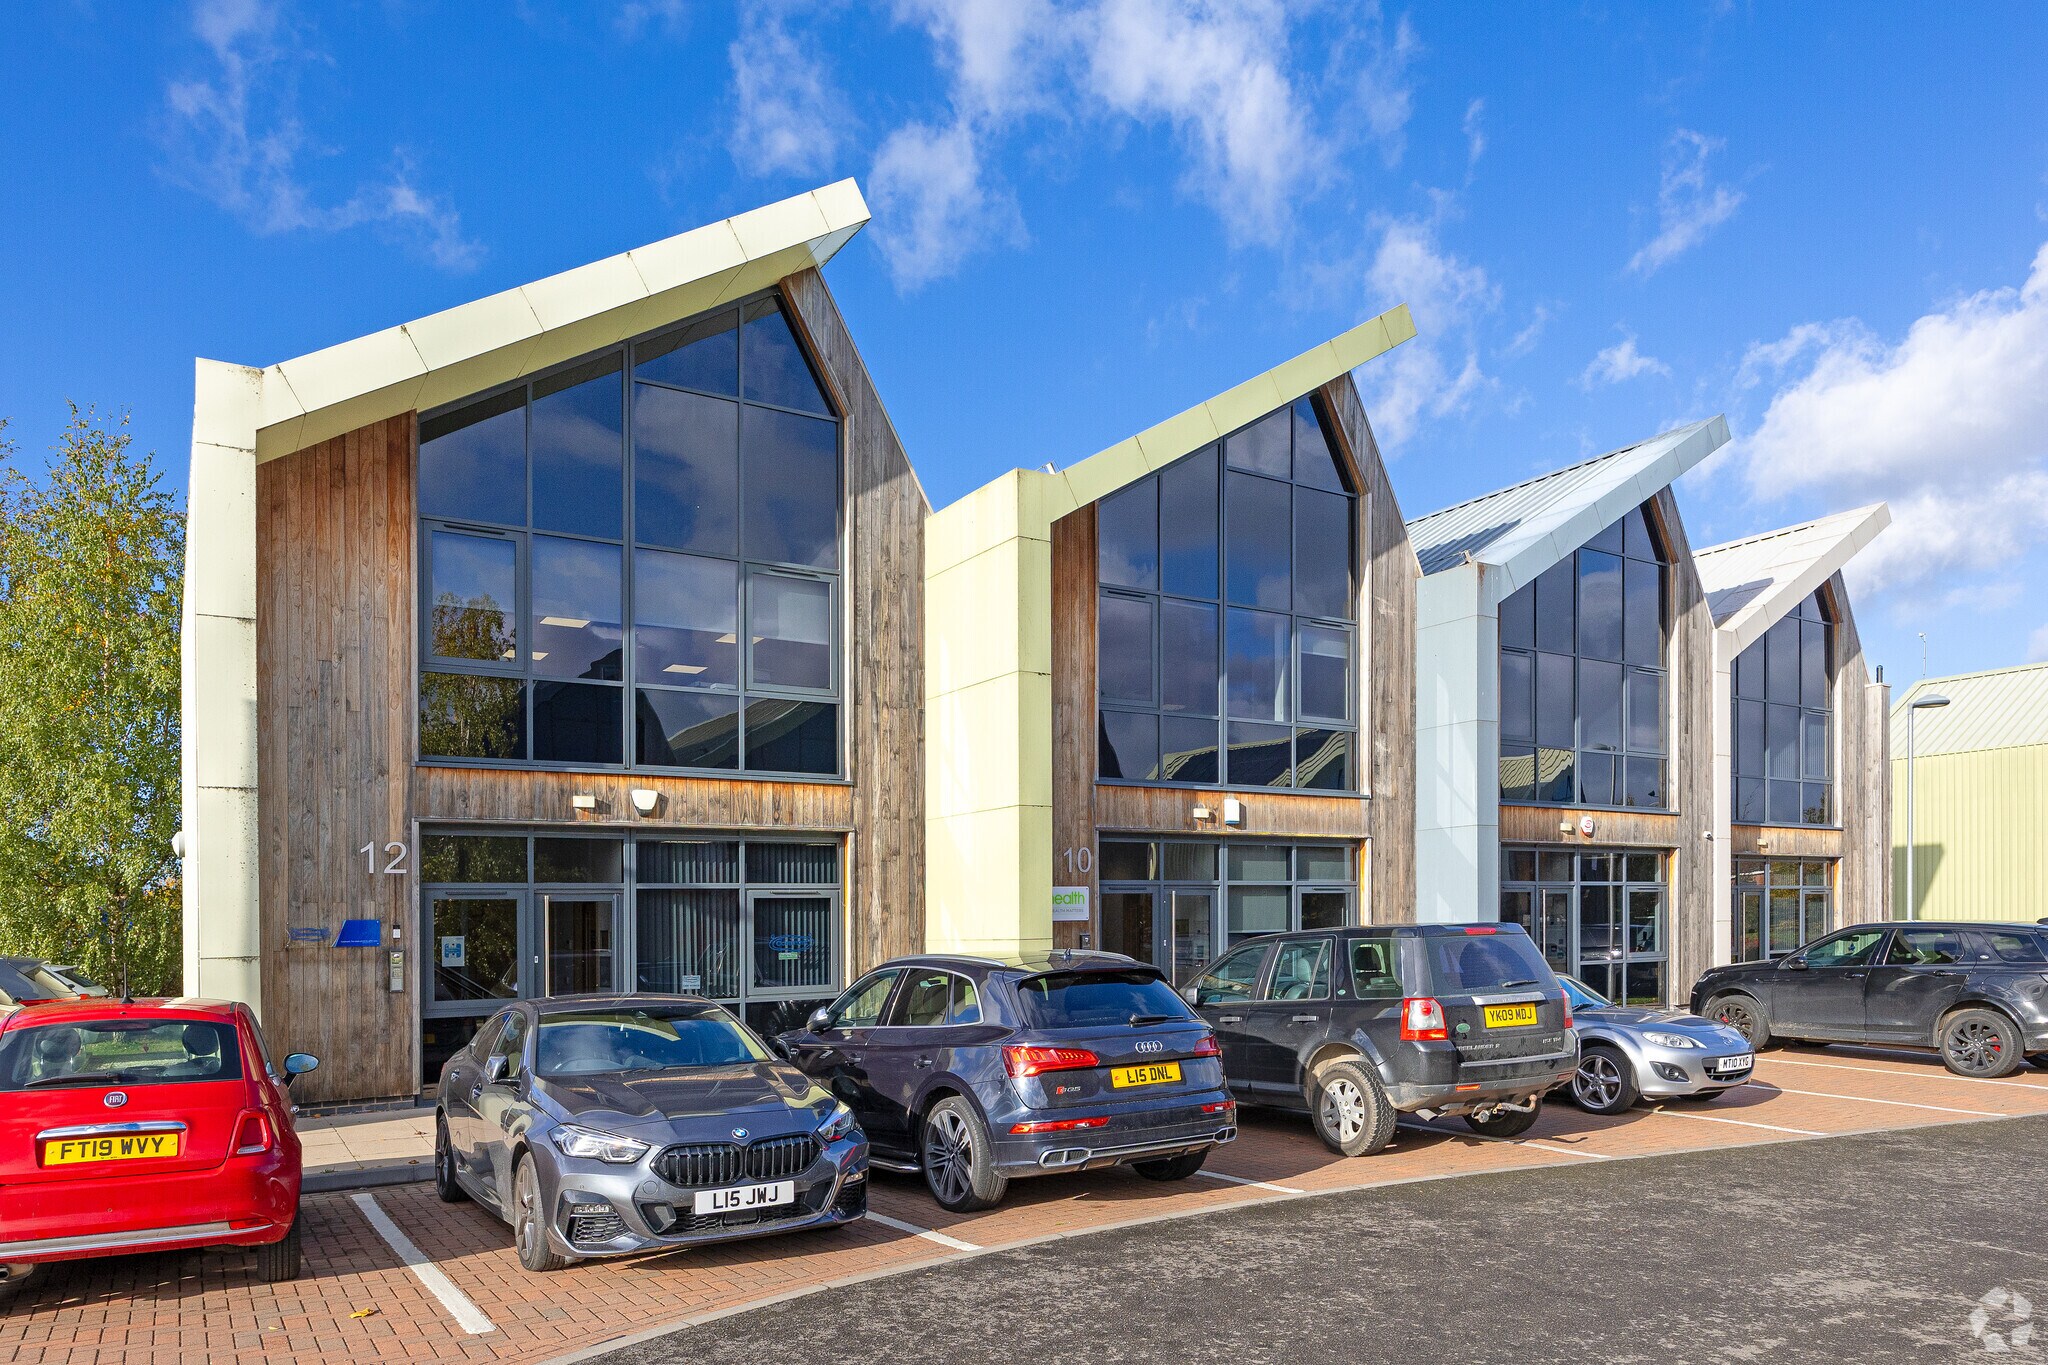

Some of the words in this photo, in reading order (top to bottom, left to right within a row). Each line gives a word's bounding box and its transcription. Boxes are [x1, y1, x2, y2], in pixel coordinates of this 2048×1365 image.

[361, 841, 408, 874] 12
[1063, 847, 1091, 873] 10
[1053, 891, 1085, 905] ealth
[1489, 1009, 1514, 1022] YK09
[1515, 1008, 1533, 1020] MDJ
[1127, 1070, 1147, 1083] L15
[1149, 1066, 1173, 1081] DNL
[110, 1095, 122, 1103] FIAT
[60, 1140, 113, 1160] FT19
[121, 1137, 165, 1155] WVY
[713, 1190, 741, 1210] L15
[746, 1185, 779, 1205] JWJ
